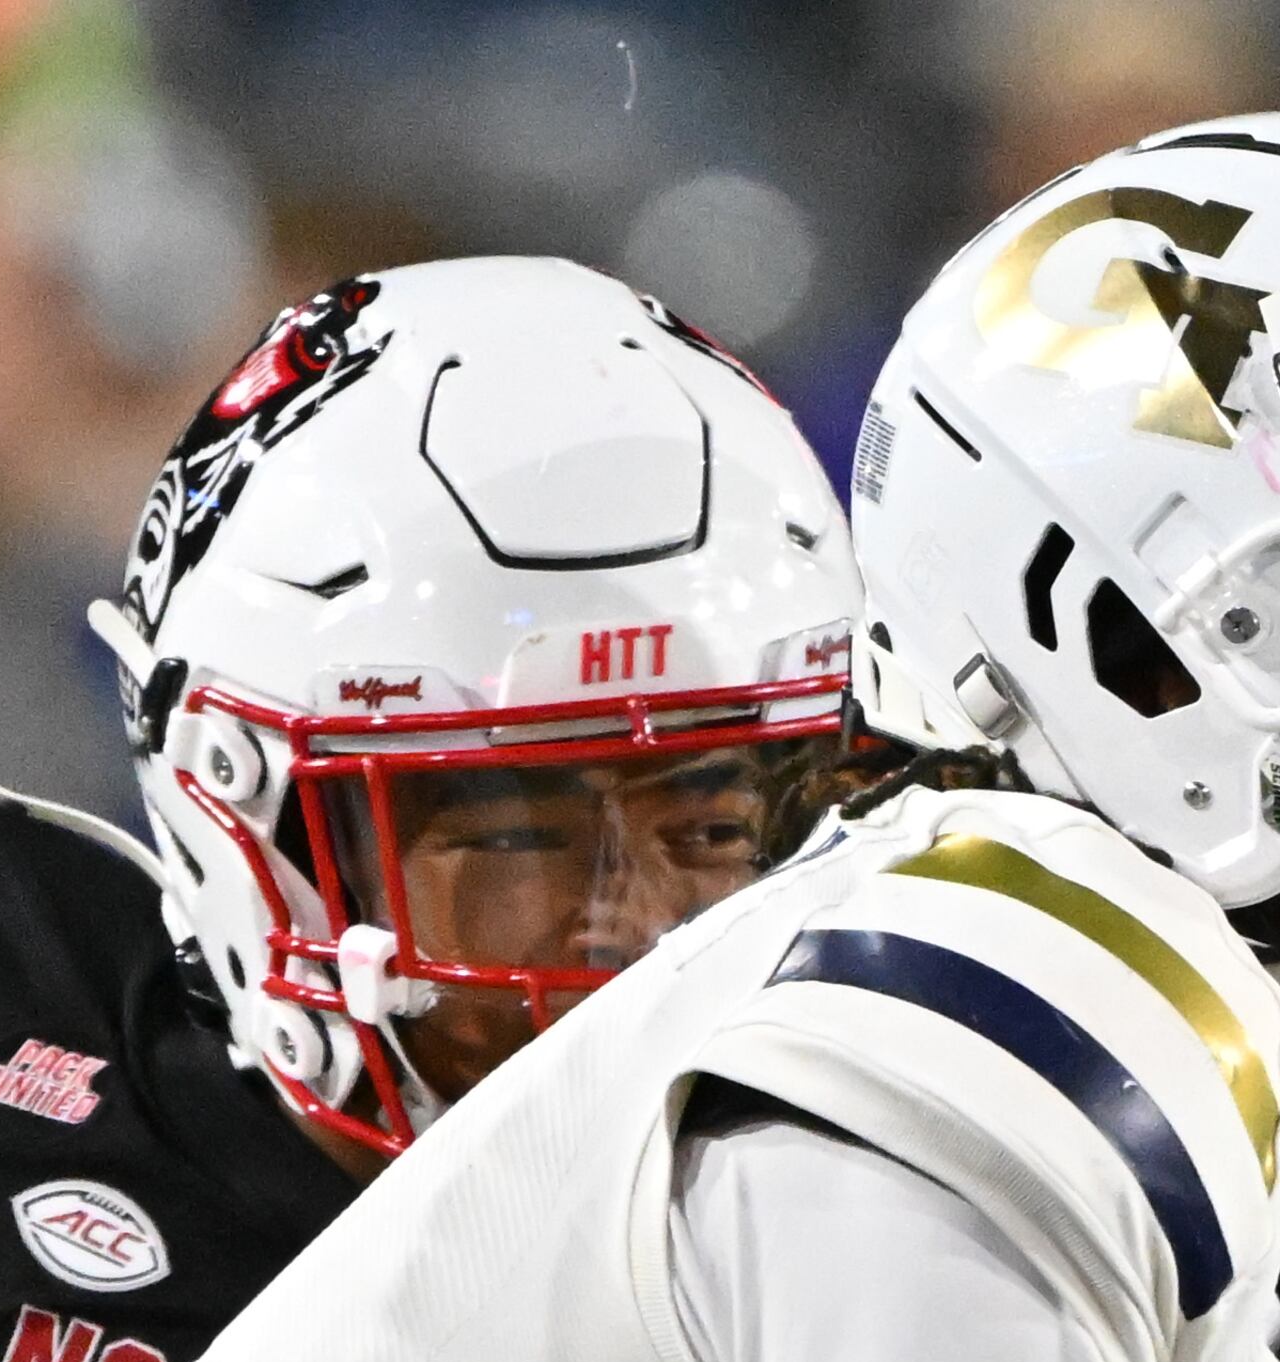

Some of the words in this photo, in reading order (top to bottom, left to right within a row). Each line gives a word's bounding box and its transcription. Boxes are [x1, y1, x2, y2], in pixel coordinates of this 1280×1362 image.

[579, 623, 674, 685] HTT
[9, 1038, 110, 1088] PACK
[42, 1209, 148, 1263] ACC
